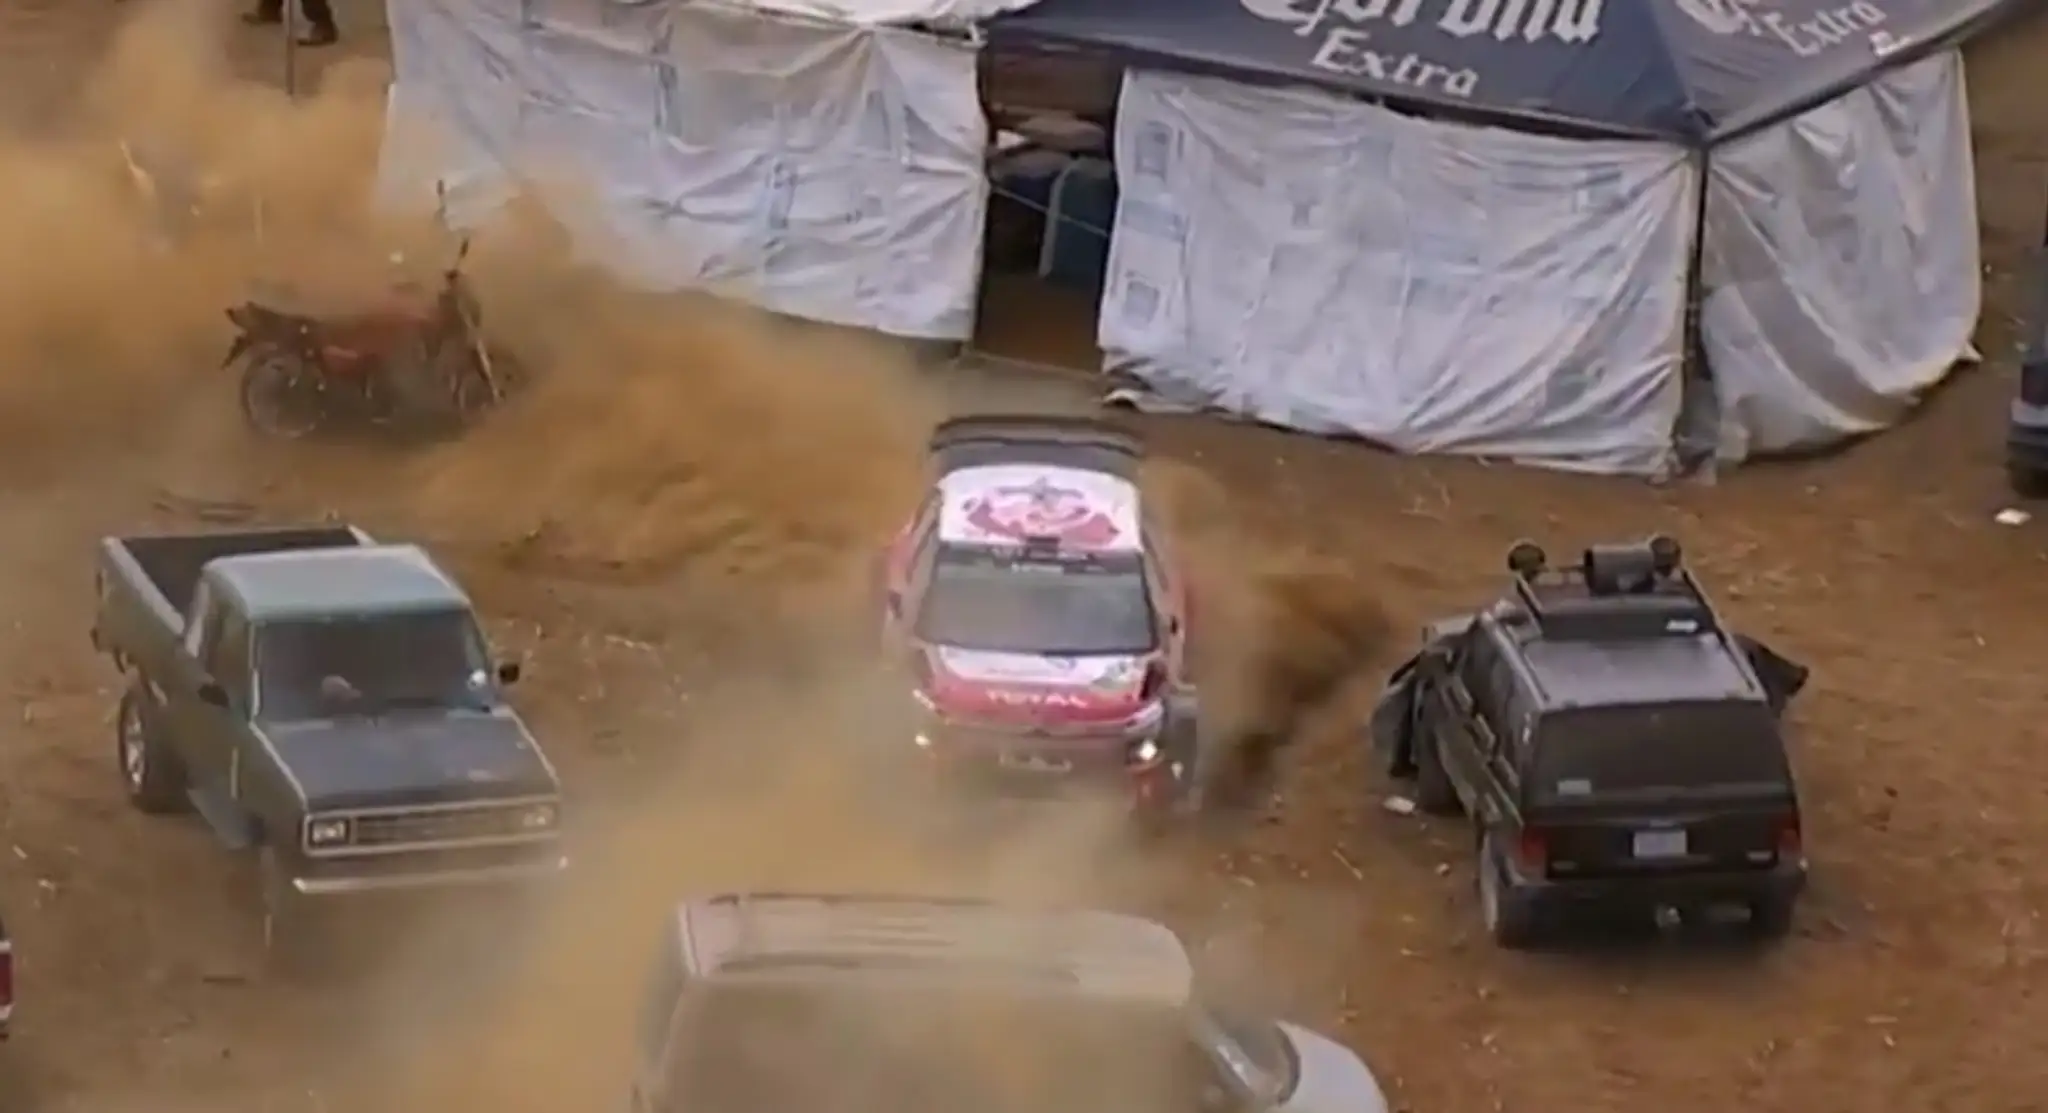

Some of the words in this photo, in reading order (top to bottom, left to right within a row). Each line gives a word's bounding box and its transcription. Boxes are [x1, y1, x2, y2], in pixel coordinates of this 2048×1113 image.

[1761, 1, 1888, 57] Extra
[1310, 27, 1480, 98] Extra
[984, 688, 1088, 709] TOTAL
